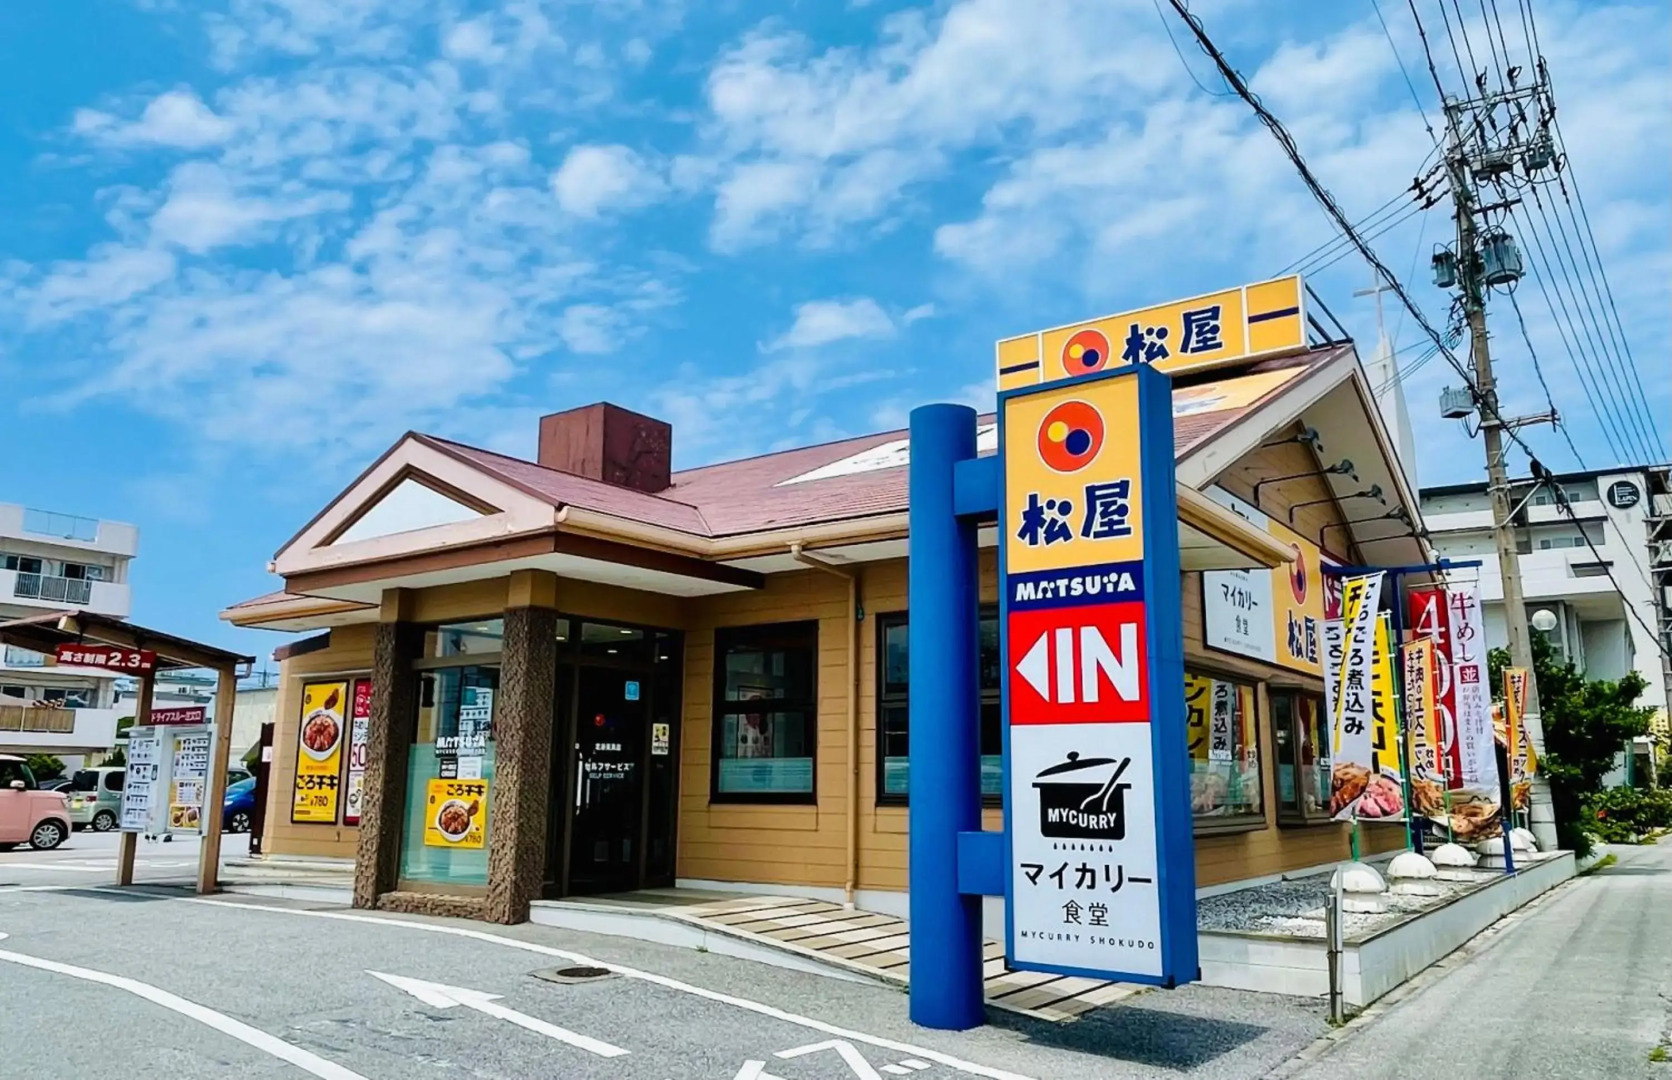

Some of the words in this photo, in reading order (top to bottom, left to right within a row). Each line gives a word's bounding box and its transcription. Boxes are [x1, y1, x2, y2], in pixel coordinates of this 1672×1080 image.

[1121, 305, 1224, 364] 松屋
[1017, 479, 1133, 547] 松屋
[1015, 572, 1136, 602] MATSUYA
[1220, 583, 1259, 612] マイカリー
[1287, 609, 1320, 665] 松屋
[1450, 592, 1476, 663] 牛めし
[1055, 622, 1140, 704] IN
[1462, 667, 1478, 684] 並
[1047, 807, 1118, 830] MYCURRY
[1020, 861, 1152, 893] マイカリー
[1061, 899, 1110, 927] 食堂
[1020, 930, 1081, 943] MYCURRY
[1090, 935, 1155, 950] SHOKUDO
